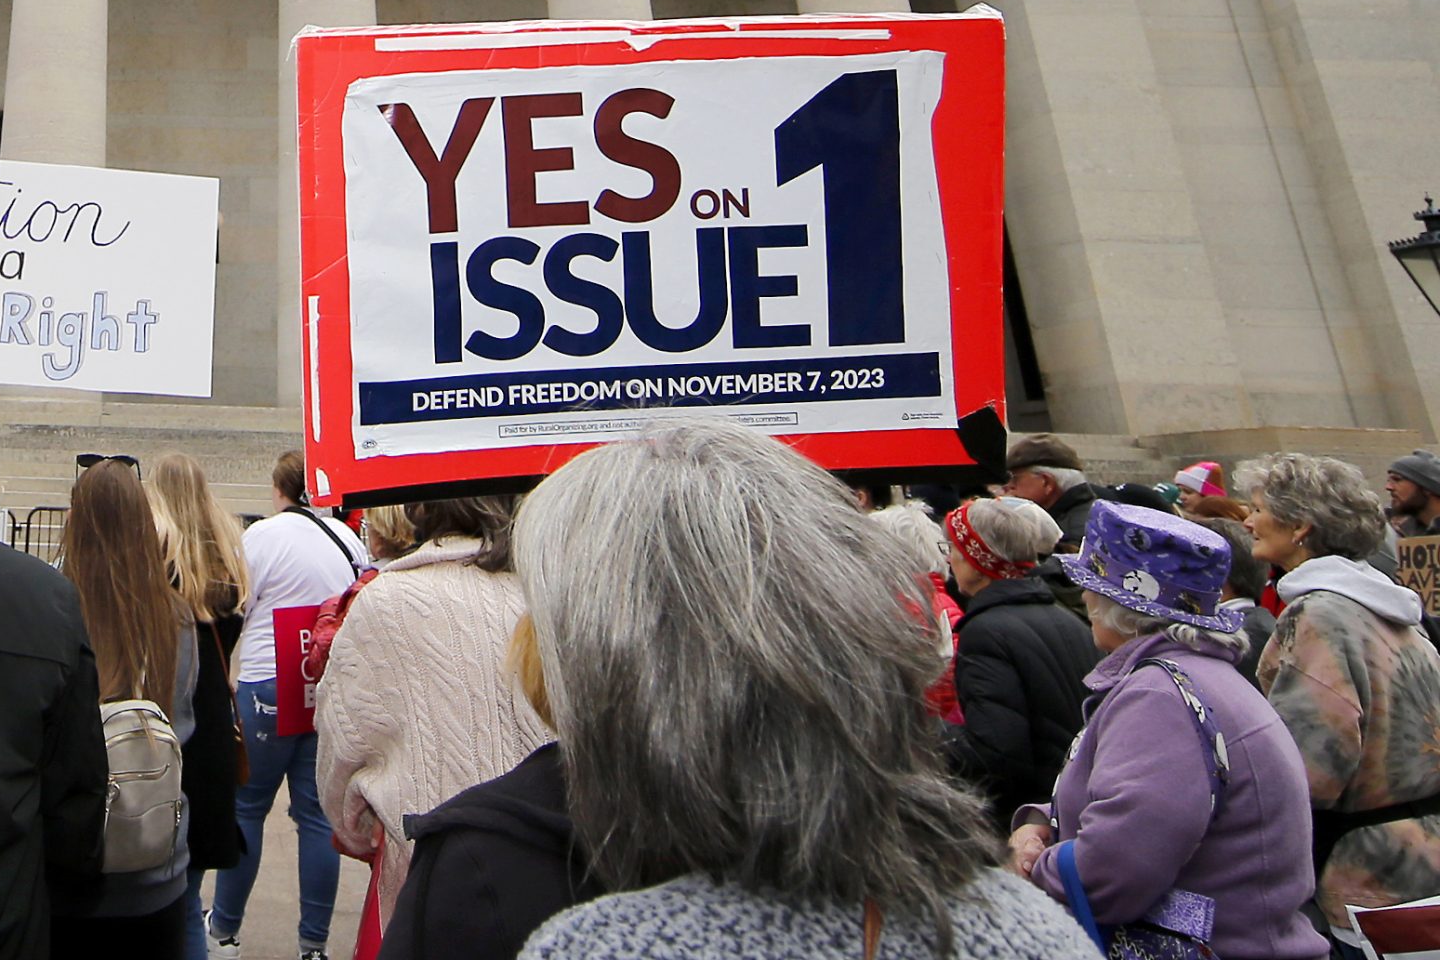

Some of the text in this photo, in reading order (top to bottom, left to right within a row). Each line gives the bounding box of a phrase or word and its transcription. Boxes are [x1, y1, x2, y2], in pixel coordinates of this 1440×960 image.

[377, 87, 750, 235] YES ON
[430, 69, 906, 365] ISSUE 1
[0, 290, 160, 382] Right
[412, 367, 886, 412] DEFEND FREEDOM ON NOVEMBER 7, 2023
